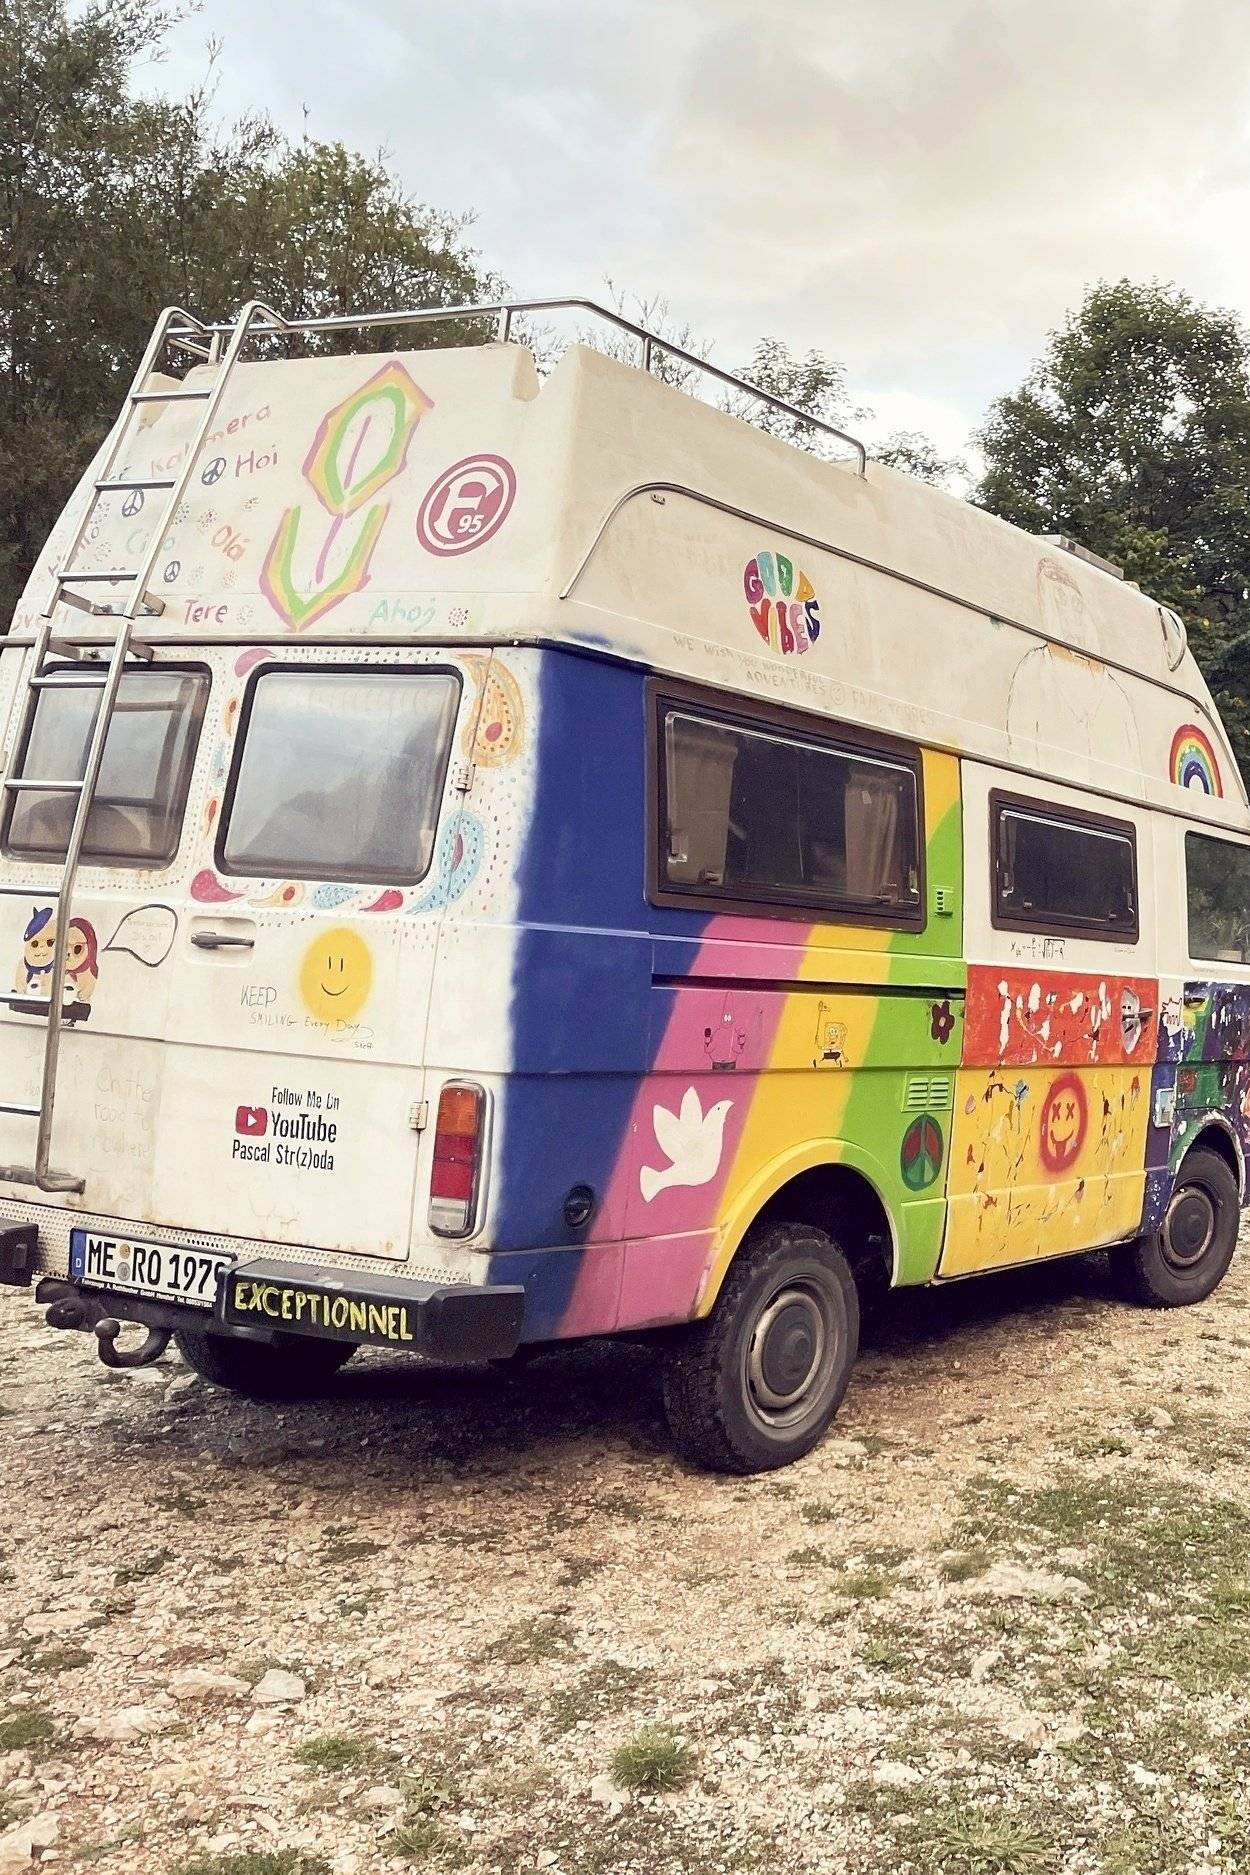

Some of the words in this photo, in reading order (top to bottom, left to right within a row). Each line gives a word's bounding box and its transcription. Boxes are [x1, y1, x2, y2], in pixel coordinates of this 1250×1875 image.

[151, 405, 271, 479] Kalmera
[235, 444, 279, 478] Hoi
[456, 514, 485, 534] 95
[184, 599, 228, 625] Tere
[369, 597, 436, 632] Ahoj
[240, 984, 277, 1008] KEEP
[249, 1011, 297, 1027] SMILING
[271, 1086, 303, 1107] Follow
[306, 1090, 322, 1109] Me
[271, 1110, 338, 1143] YouTube
[232, 1139, 271, 1163] Pascal
[275, 1143, 335, 1171] Str(z)oda
[87, 1239, 117, 1278] ME
[131, 1246, 162, 1286] RO
[234, 1282, 413, 1341] EXCEPTIONNEL
